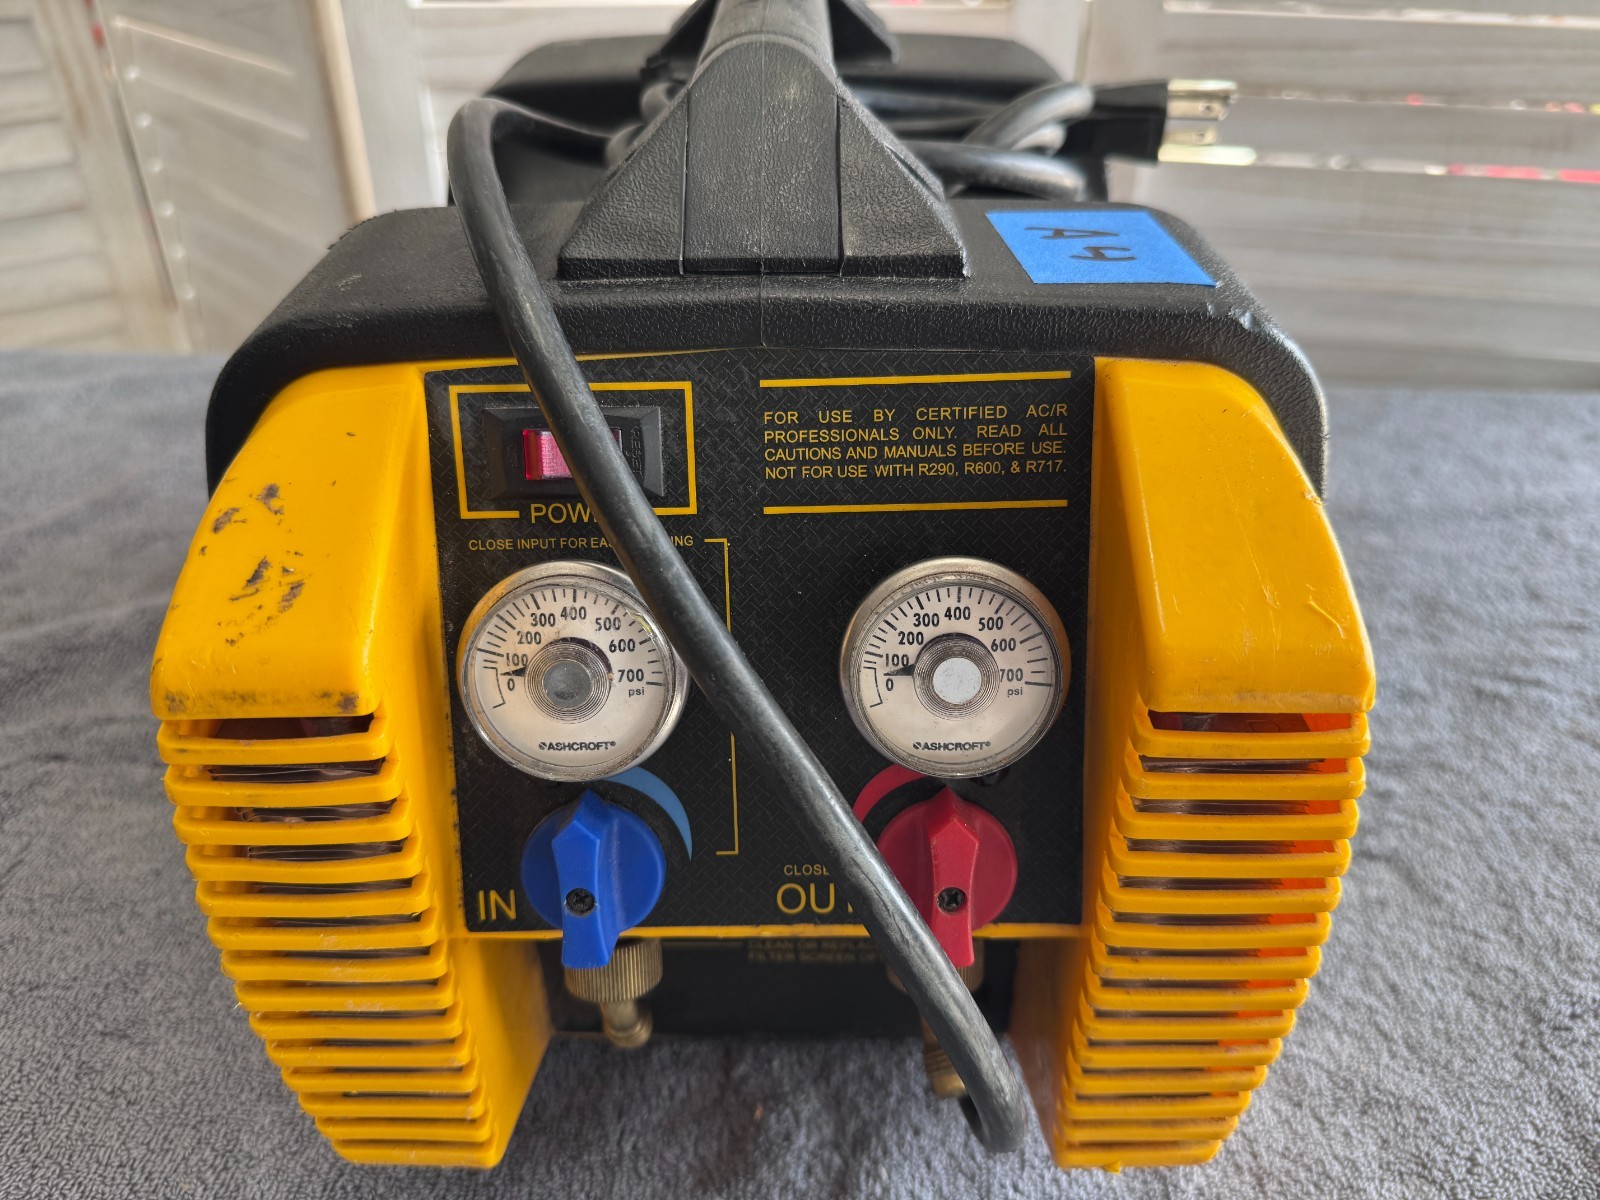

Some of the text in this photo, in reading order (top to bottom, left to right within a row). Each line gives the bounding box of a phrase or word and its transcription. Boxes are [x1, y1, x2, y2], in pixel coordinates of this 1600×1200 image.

[763, 403, 1068, 425] FOR USE BY CERTIFIED AC/R
[764, 423, 1068, 443] PROFESSIONALS ONLY. READ ALL
[764, 440, 1067, 462] CAUTIONS AND MANUALS BEFORE USE.
[765, 459, 1067, 480] NOT FOR USE WITH R290, R600, & R717.
[530, 503, 598, 524] POW
[468, 538, 514, 551] CLOSE
[517, 537, 556, 550] INPUT
[560, 537, 588, 549] FOR
[530, 612, 556, 628] 300
[560, 606, 587, 620] 400
[913, 612, 940, 628] 300
[944, 606, 971, 621] 400
[595, 617, 622, 632] 500
[978, 617, 1004, 632] 500
[516, 631, 542, 646] 200
[608, 639, 636, 653] 600
[898, 631, 924, 646] 200
[990, 638, 1017, 653] 600
[505, 653, 529, 668] 100
[885, 653, 910, 668] 100
[617, 668, 644, 683] 700
[999, 668, 1024, 682] 700
[507, 678, 516, 692] 0
[628, 686, 645, 697] psi
[885, 678, 894, 692] 0
[1007, 687, 1023, 697] psi
[478, 888, 517, 921] IN
[776, 882, 853, 914] OU
